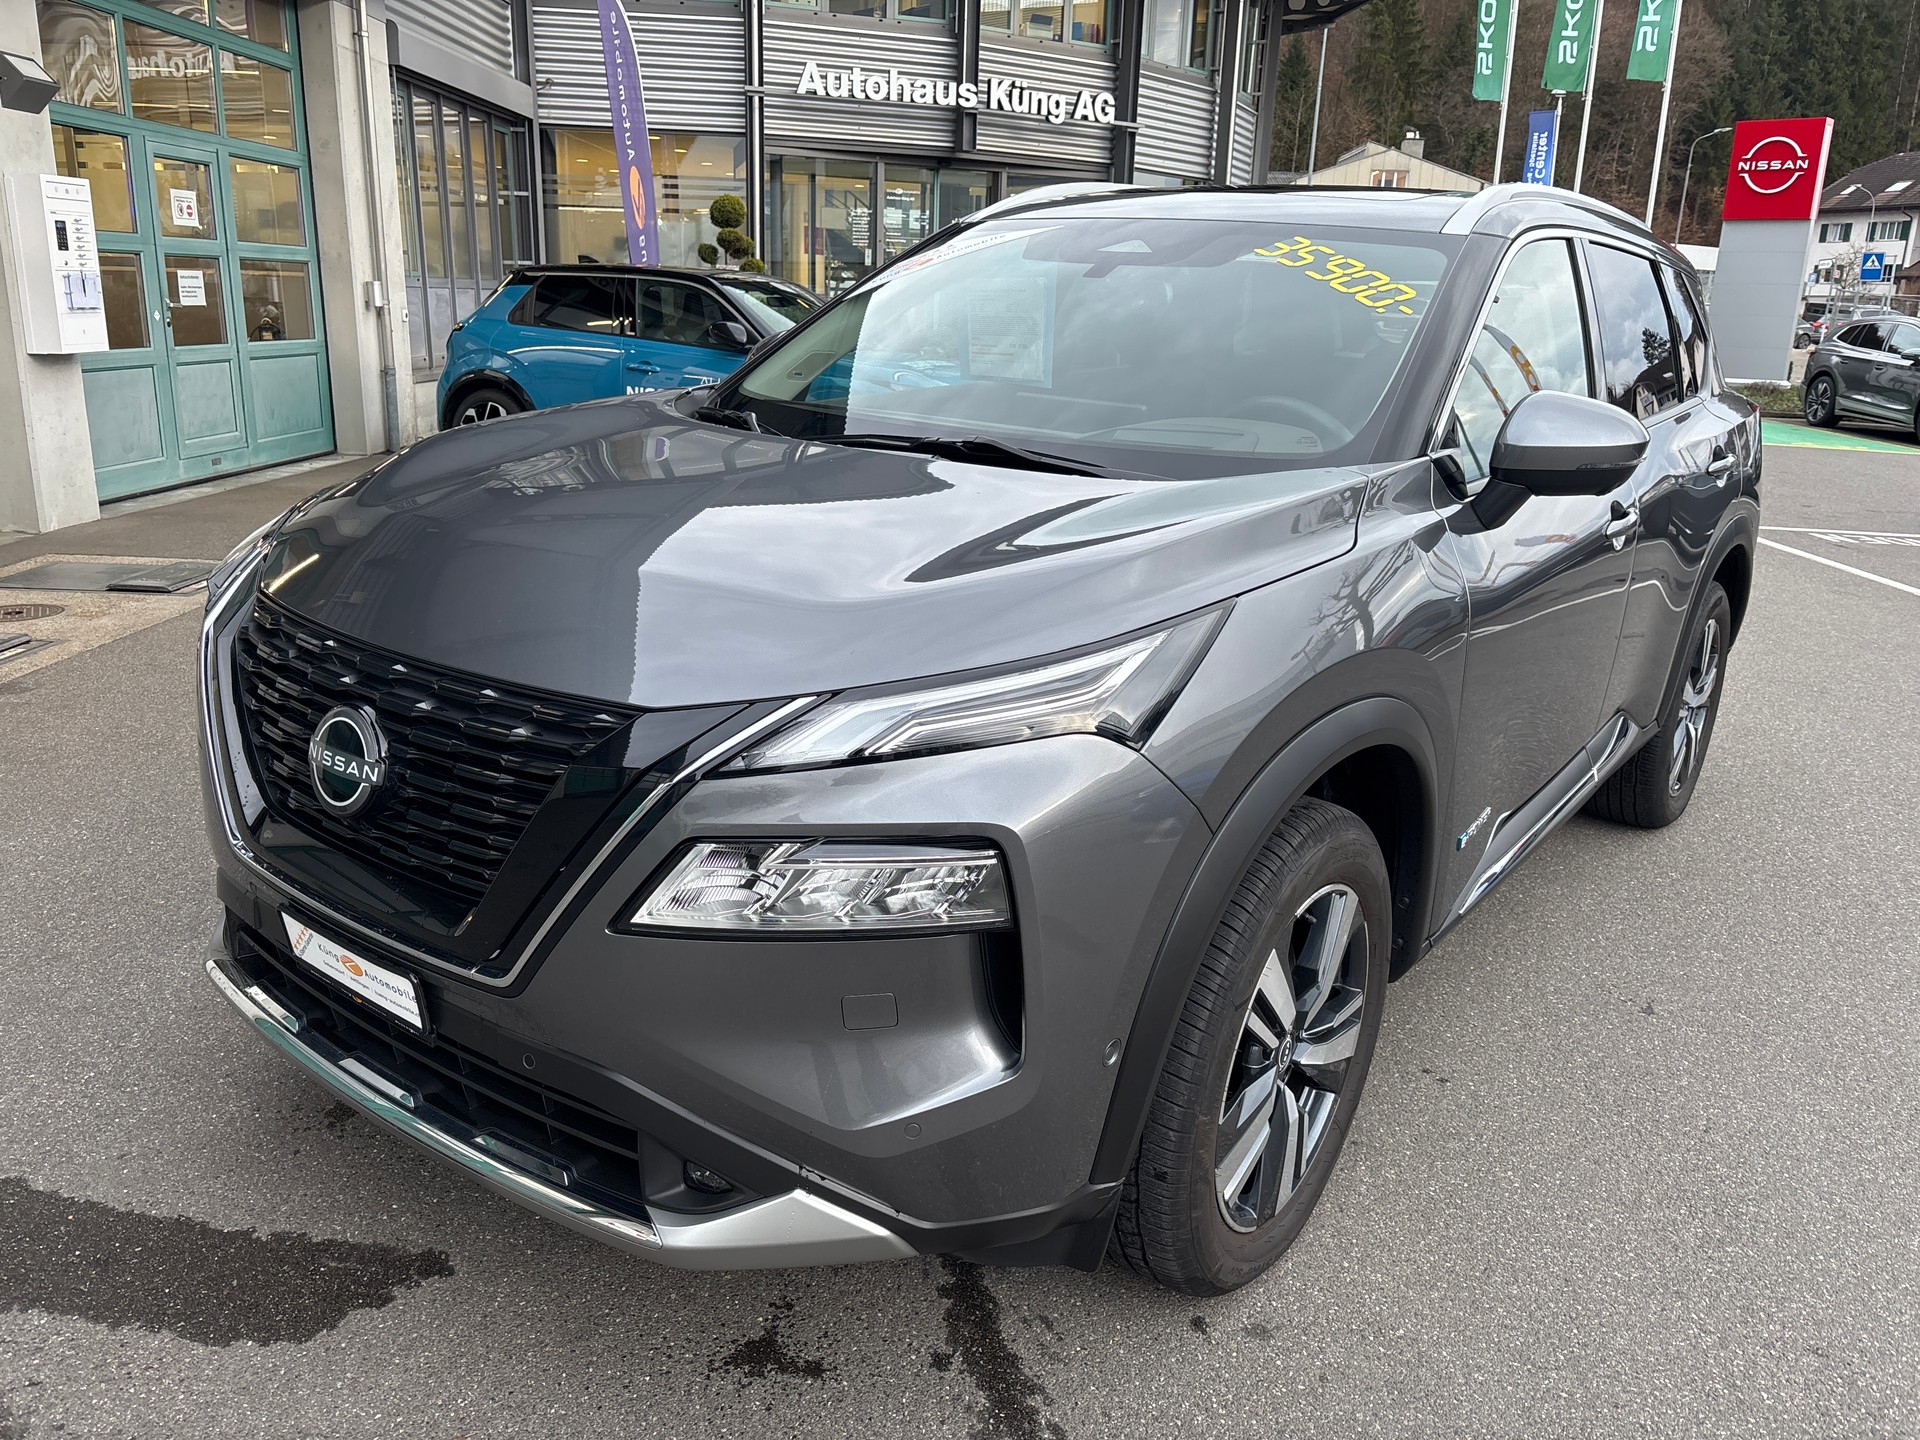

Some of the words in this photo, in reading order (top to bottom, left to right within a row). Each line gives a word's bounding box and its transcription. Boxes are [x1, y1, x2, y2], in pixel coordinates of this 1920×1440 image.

[796, 61, 978, 108] Autohaus
[989, 77, 1067, 125] Küng
[1073, 90, 1116, 124] AG
[1737, 159, 1809, 171] NISSAN
[309, 741, 379, 782] NISSAN
[317, 943, 340, 963] Küng
[364, 969, 418, 1004] Automobile
